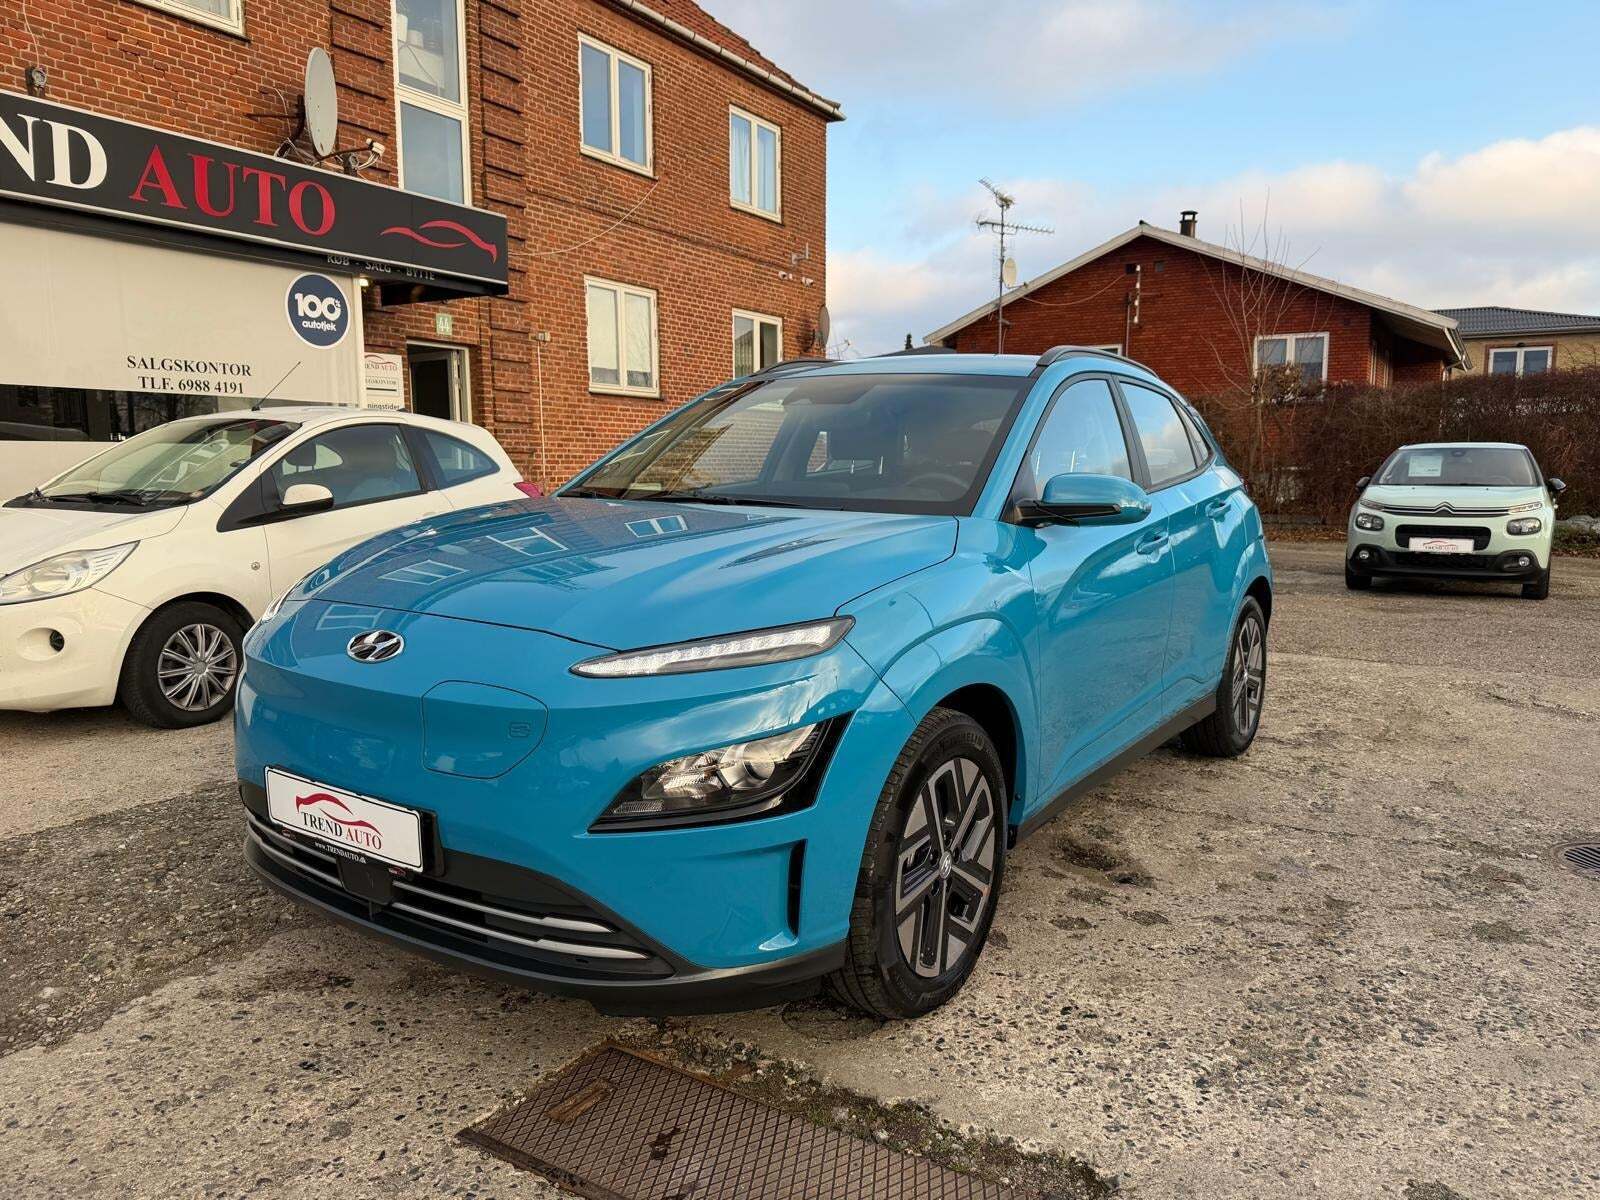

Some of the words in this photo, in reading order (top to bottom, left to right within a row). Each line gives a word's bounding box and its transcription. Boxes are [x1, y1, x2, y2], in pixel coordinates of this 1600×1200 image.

[128, 143, 337, 237] AUTO
[327, 254, 350, 266] KØB
[365, 262, 392, 273] SALG
[302, 320, 337, 332] autotjek
[126, 355, 252, 377] SALGSKONTOR
[137, 376, 174, 391] TLF.
[178, 379, 210, 393] 6988
[214, 381, 244, 394] 4191
[301, 811, 343, 837] TREND
[345, 829, 382, 850] AUTO
